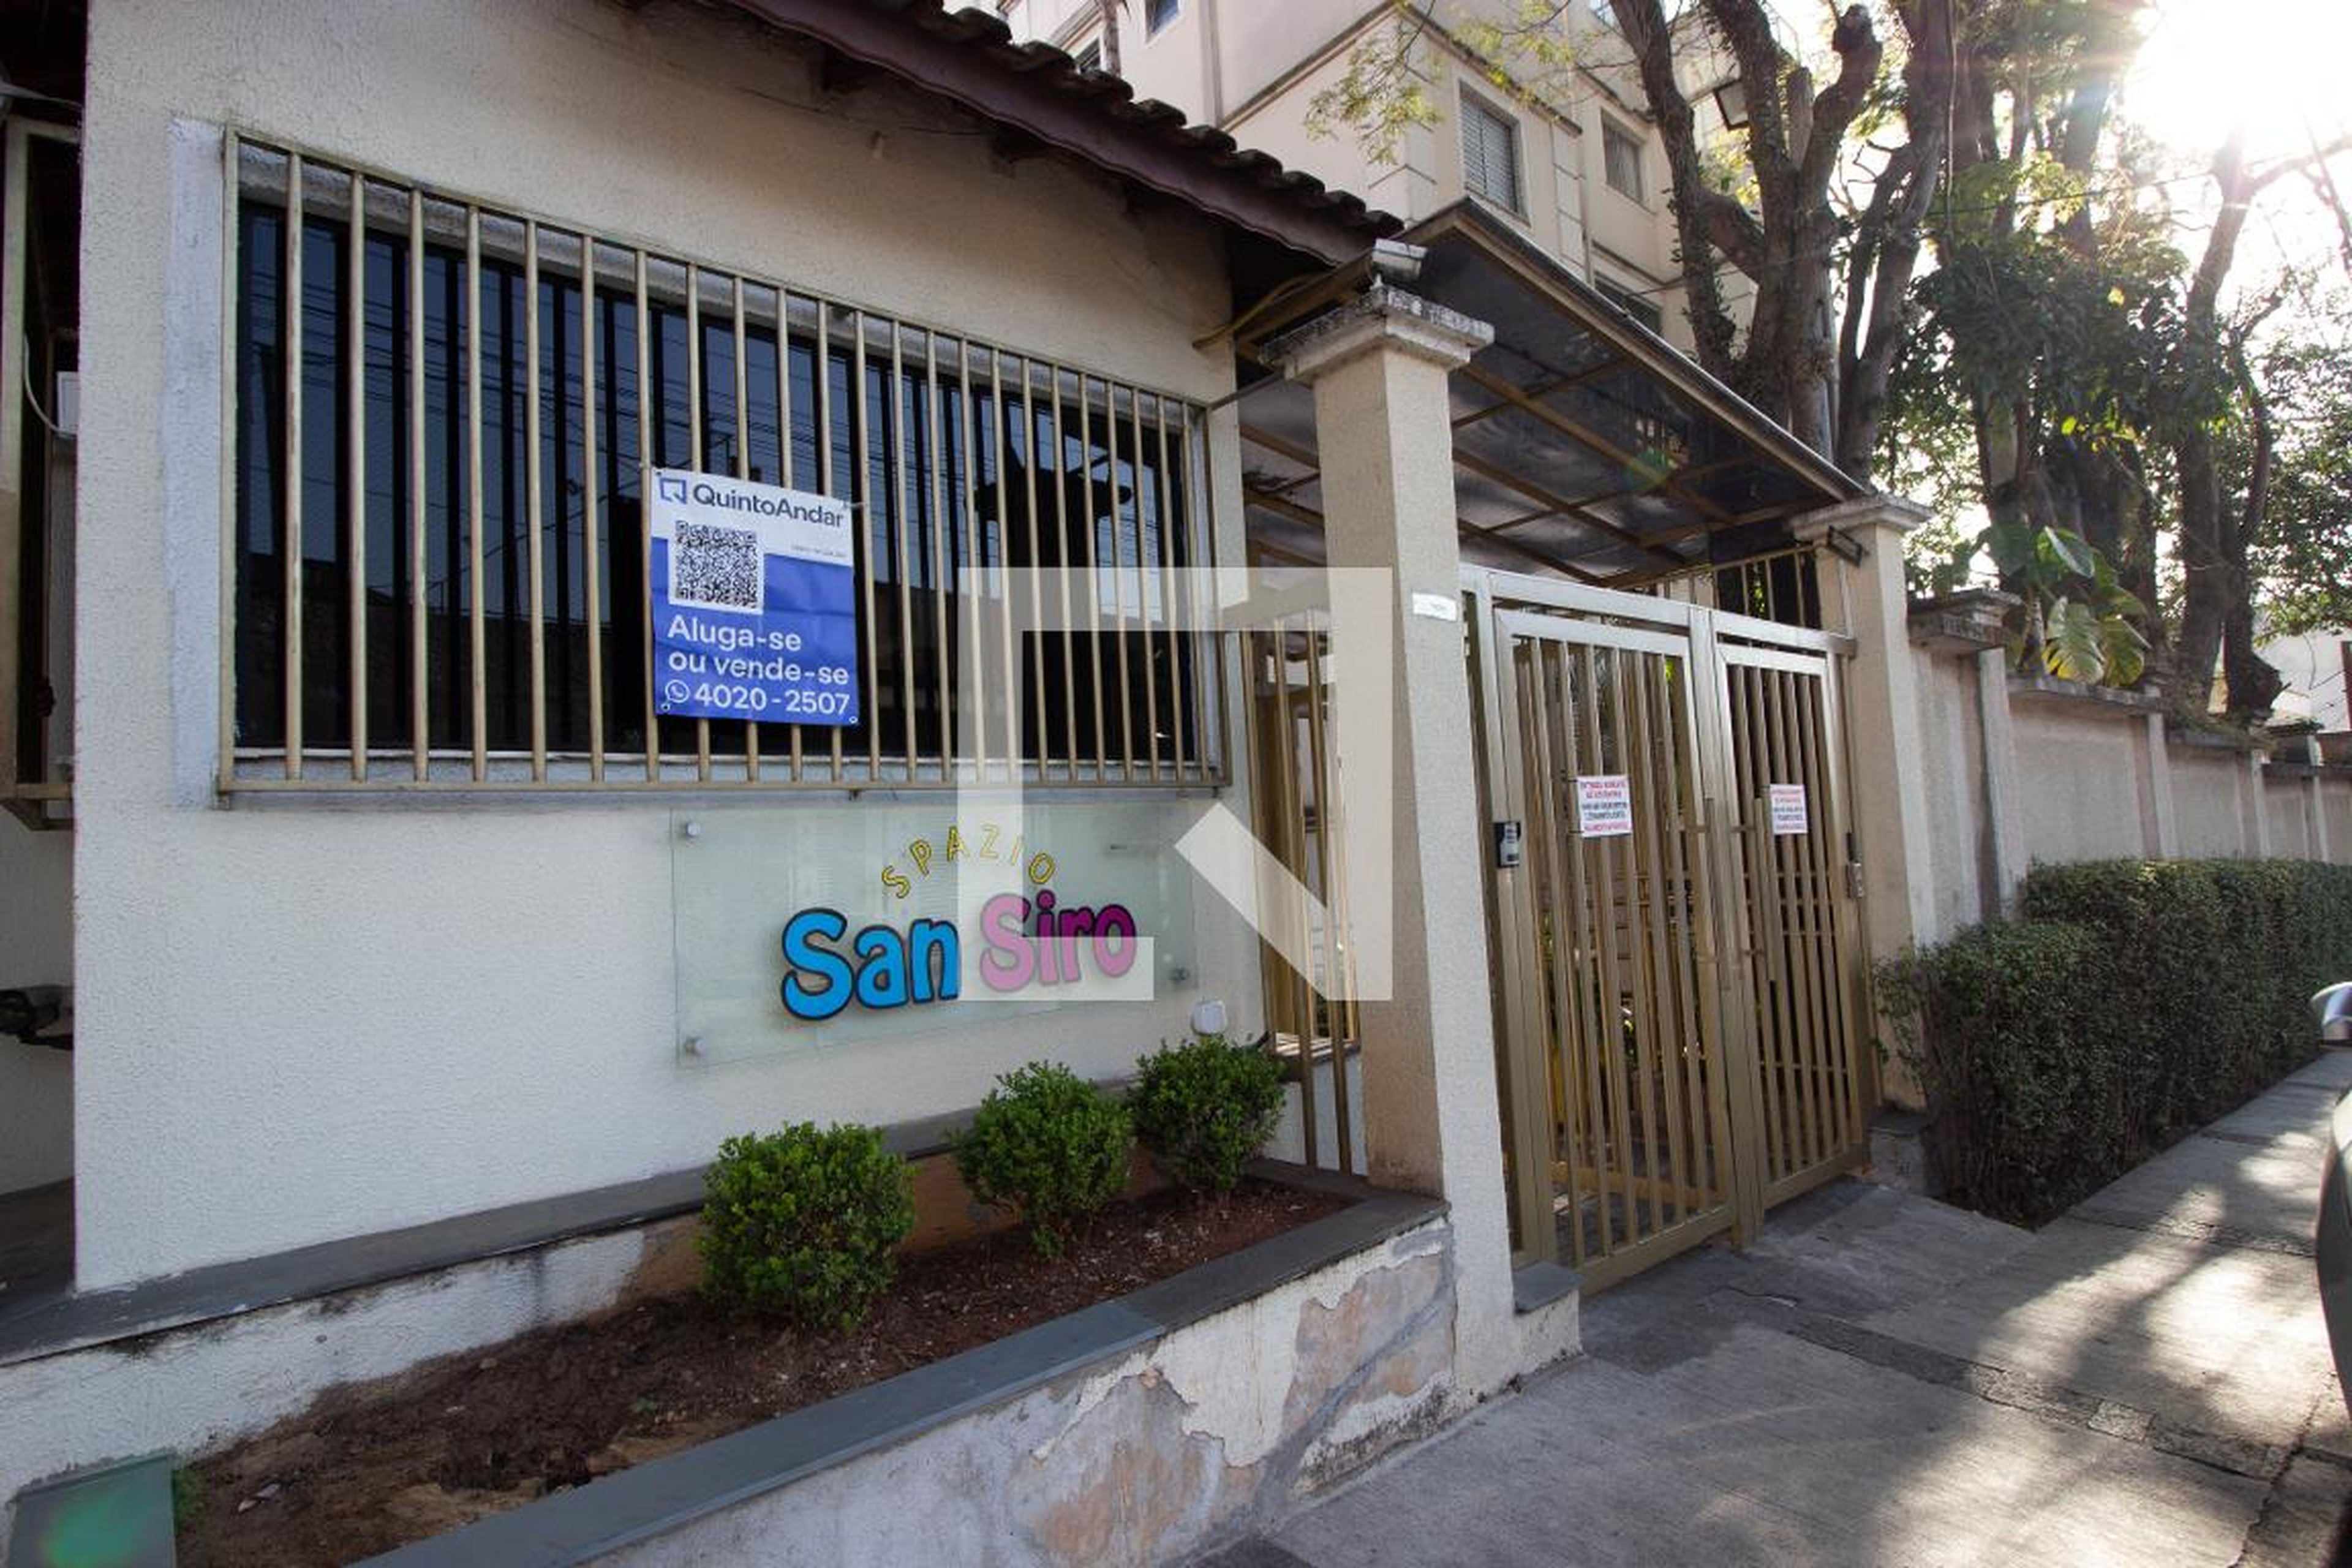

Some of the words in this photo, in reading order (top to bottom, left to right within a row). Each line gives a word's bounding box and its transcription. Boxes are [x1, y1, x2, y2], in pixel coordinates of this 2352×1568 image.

[693, 483, 844, 528] QuintoAndar
[668, 614, 802, 651] Aluga-se
[668, 652, 705, 673] ou
[714, 657, 849, 685] vende-se
[881, 824, 1057, 899] SPAZIO
[781, 907, 962, 1021] San
[979, 889, 1137, 993] Siro
